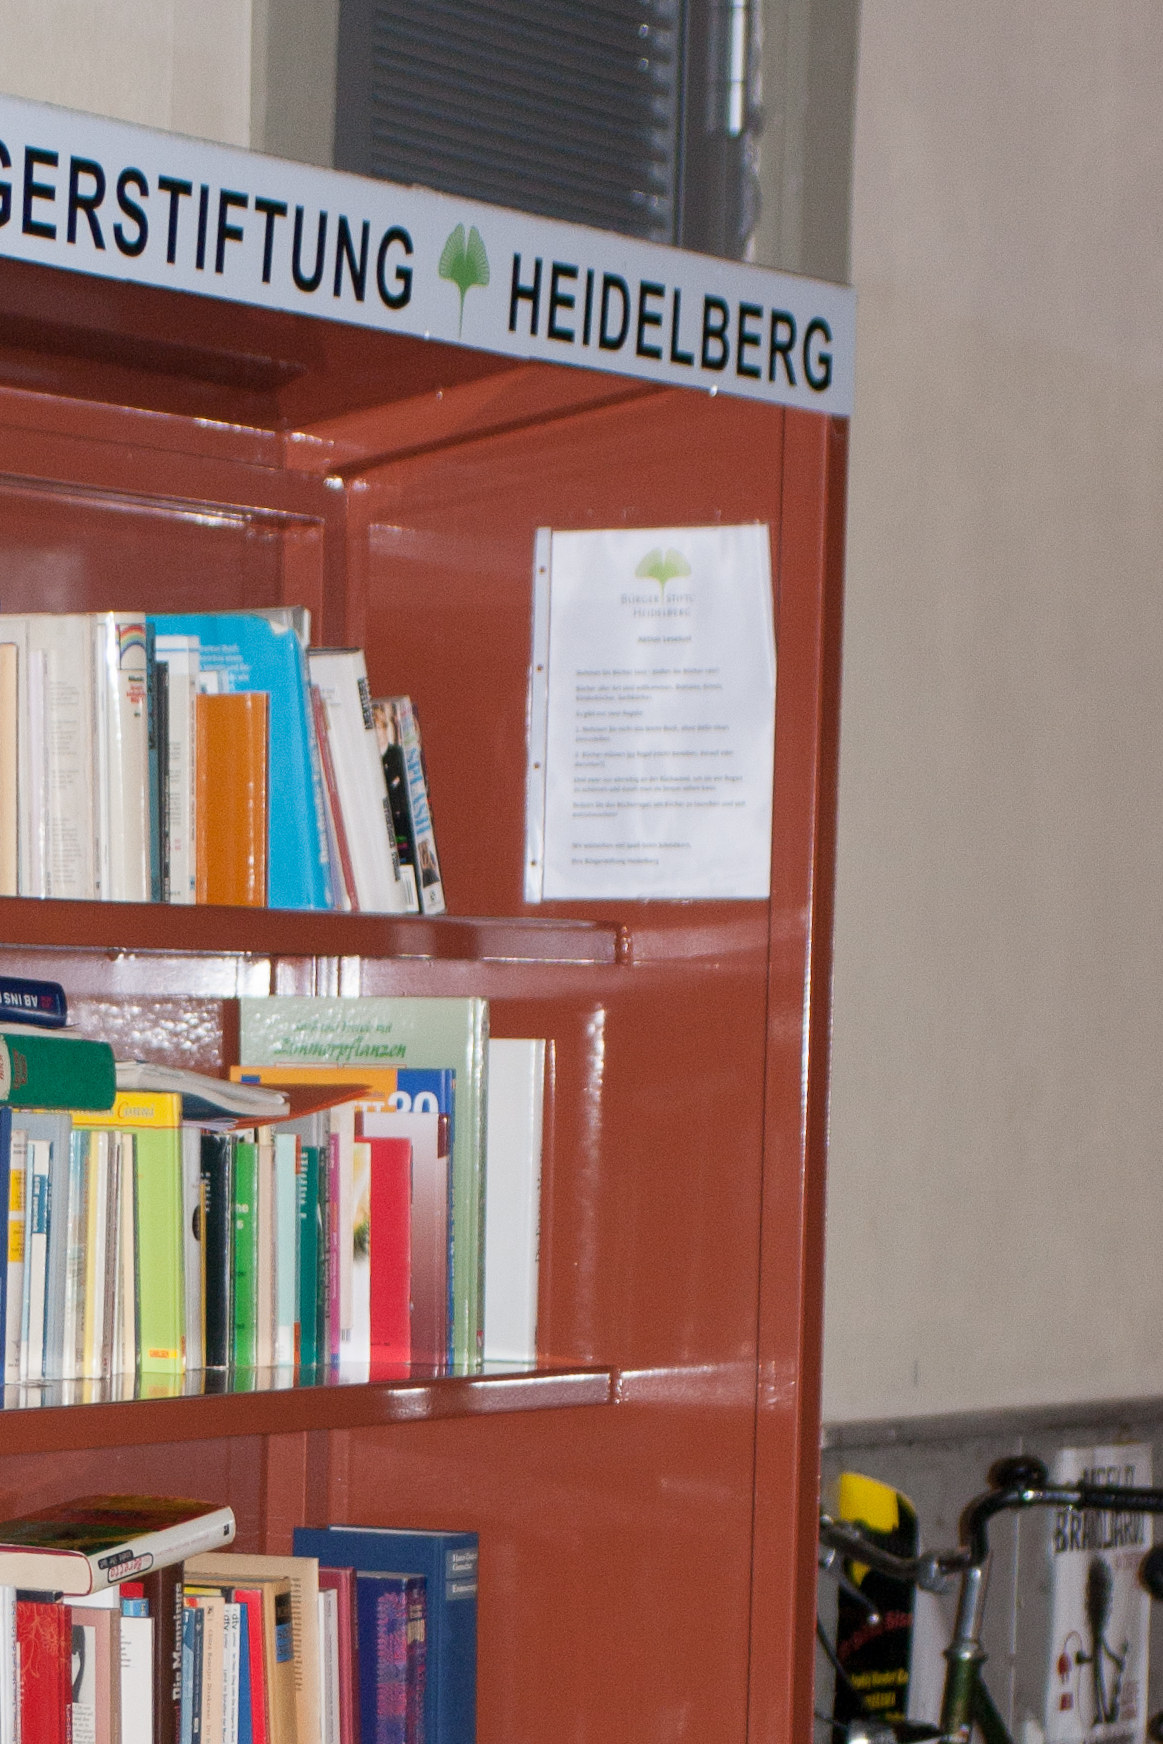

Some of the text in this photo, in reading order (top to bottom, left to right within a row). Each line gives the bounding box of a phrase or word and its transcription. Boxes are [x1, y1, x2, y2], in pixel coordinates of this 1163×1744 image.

[507, 253, 833, 393] HEIDELBERG
[4, 991, 23, 1006] INS
[23, 994, 38, 1008] AB
